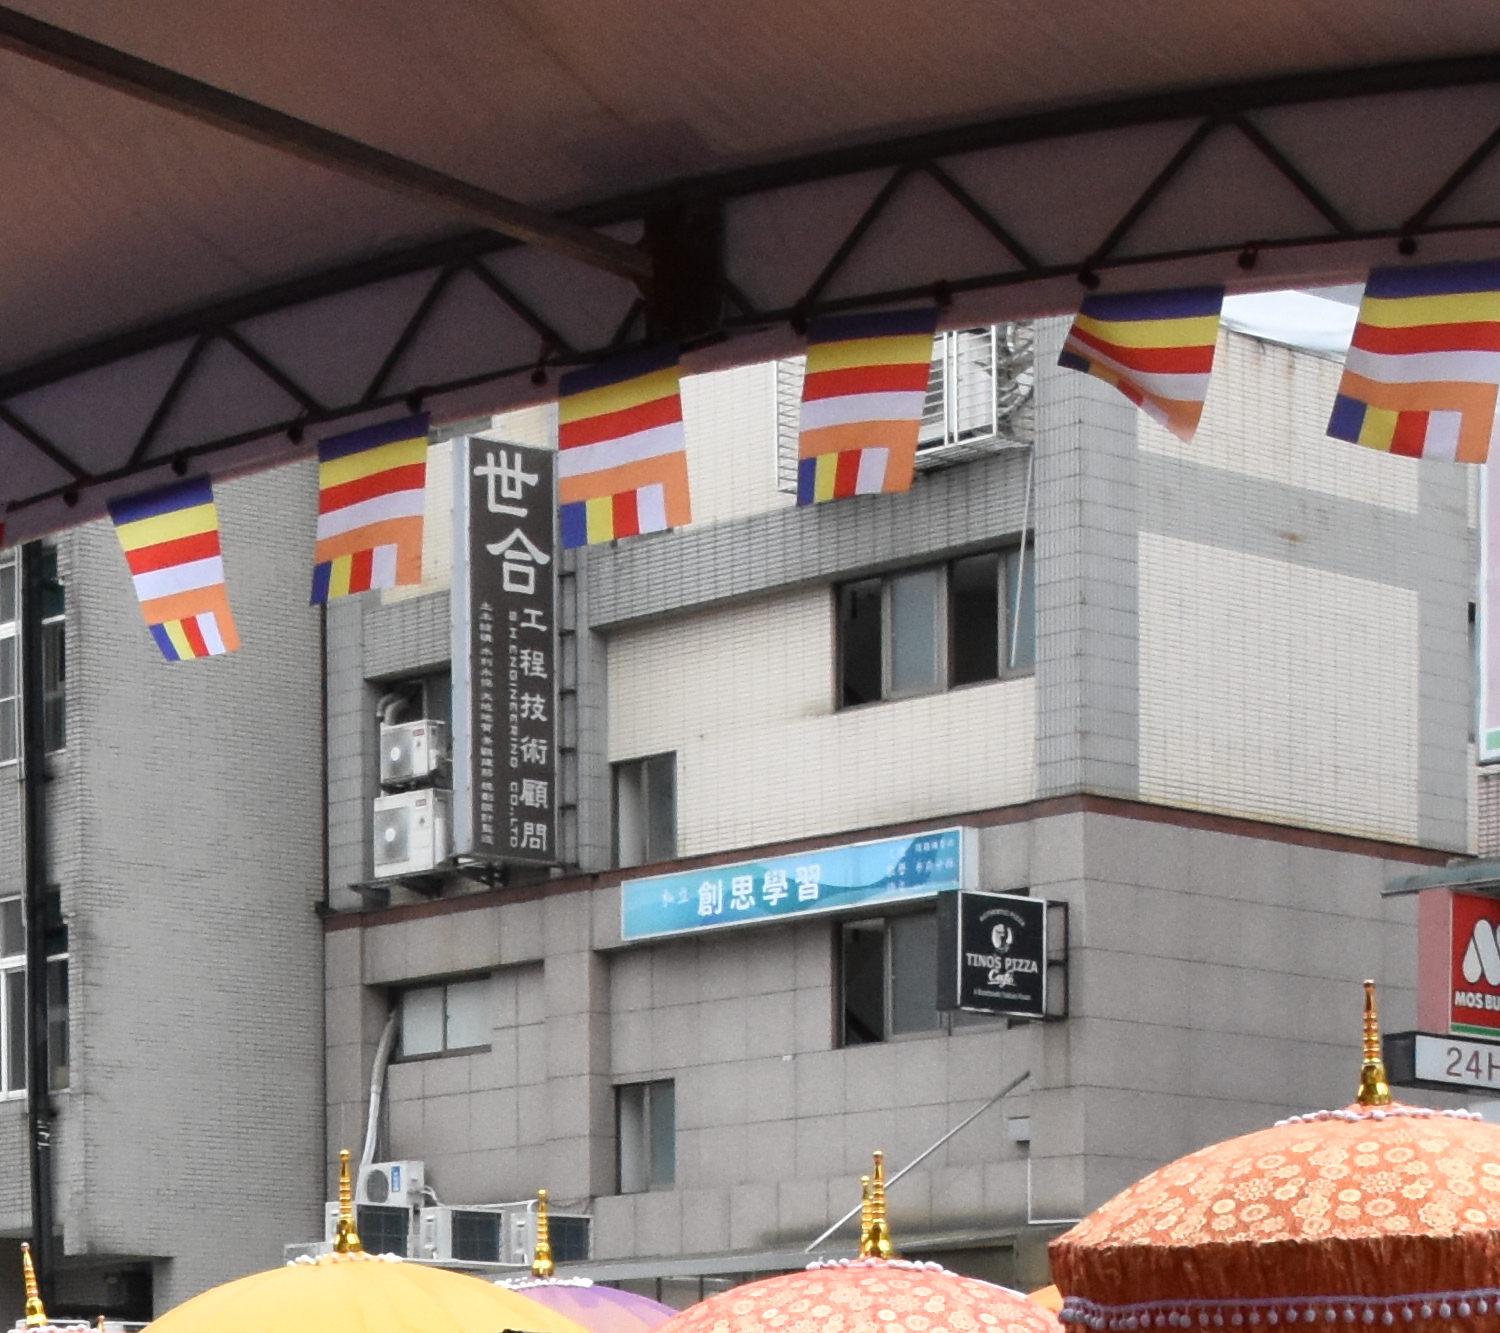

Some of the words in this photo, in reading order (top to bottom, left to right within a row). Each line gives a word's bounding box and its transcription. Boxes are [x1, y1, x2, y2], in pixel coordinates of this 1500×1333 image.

[474, 450, 550, 595] 世合
[520, 608, 549, 852] 工程技術顧問
[698, 864, 821, 917] 創思學習
[1005, 957, 1038, 974] PIZZA
[1455, 990, 1484, 1010] MOS
